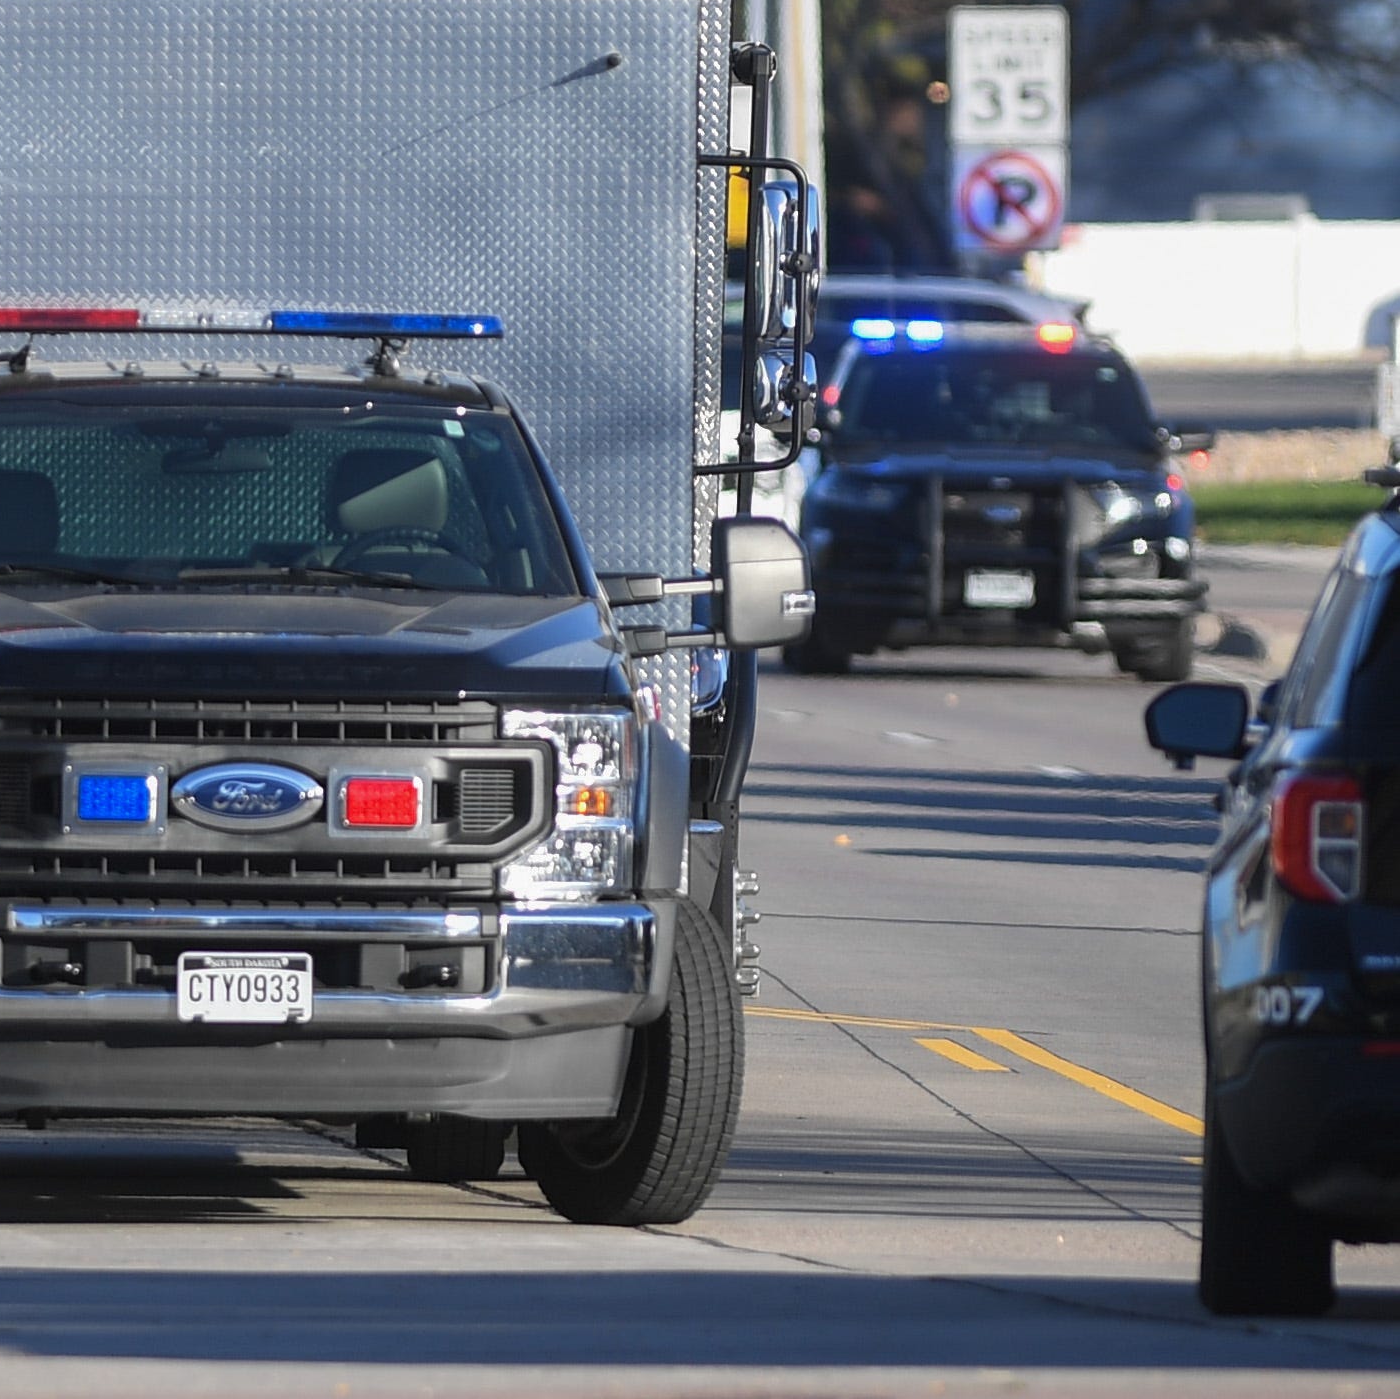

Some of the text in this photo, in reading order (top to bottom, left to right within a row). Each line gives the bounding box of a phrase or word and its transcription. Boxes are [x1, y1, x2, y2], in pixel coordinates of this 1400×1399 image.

[965, 25, 1057, 46] SPEED
[973, 53, 1044, 73] LIMIT
[970, 79, 1051, 123] 35
[213, 780, 284, 809] Ford
[210, 958, 282, 968] SOUTH DAKOTA
[189, 973, 300, 1003] CTY0933
